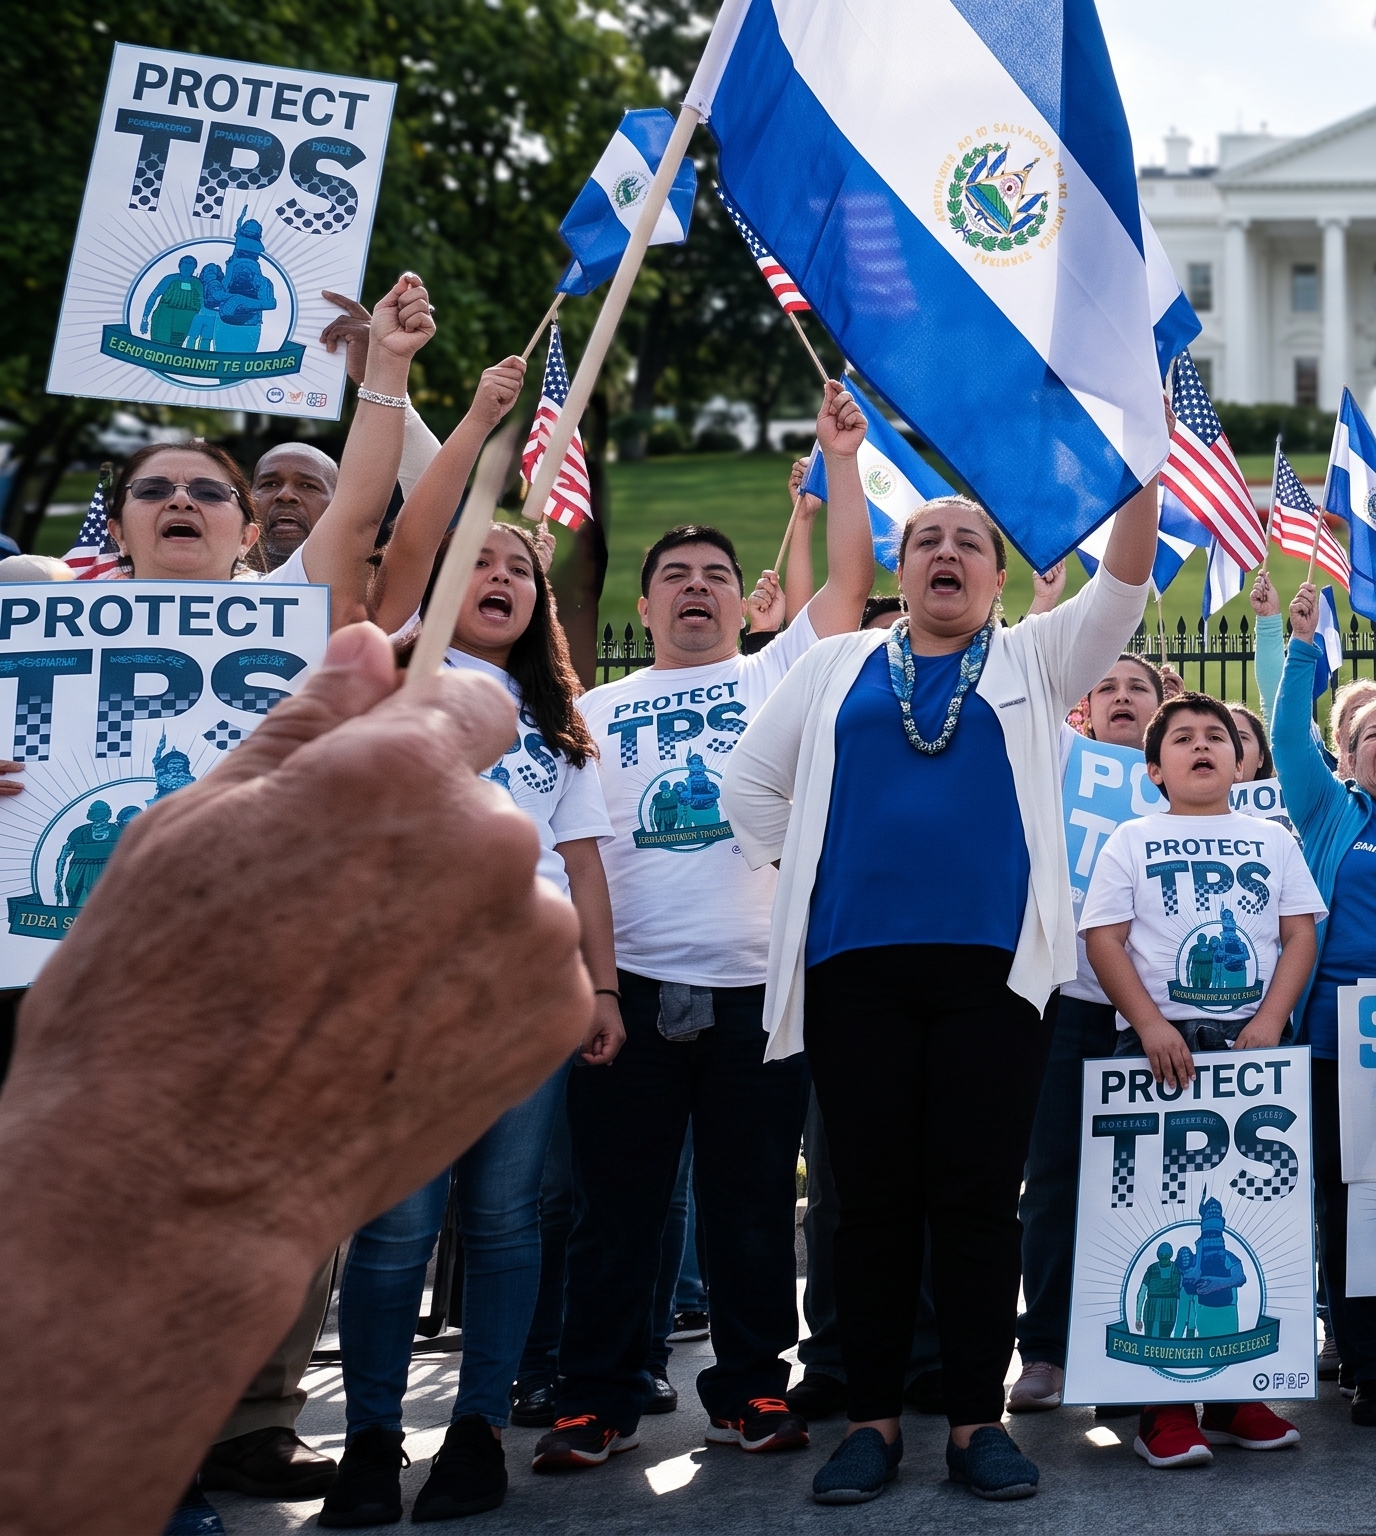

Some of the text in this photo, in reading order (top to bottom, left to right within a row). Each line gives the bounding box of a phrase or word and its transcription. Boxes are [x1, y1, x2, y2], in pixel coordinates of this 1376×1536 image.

[132, 61, 370, 131] PROTECT
[114, 107, 367, 235] TPS
[0, 594, 299, 640] PROTECT
[0, 647, 308, 762] TPS
[614, 680, 738, 719] PROTECT
[607, 700, 749, 769] TPS
[1145, 838, 1265, 860] PROTECT
[1145, 860, 1272, 917] TPS
[1101, 1060, 1291, 1104] PROTECT
[1092, 1104, 1299, 1208] TPS
